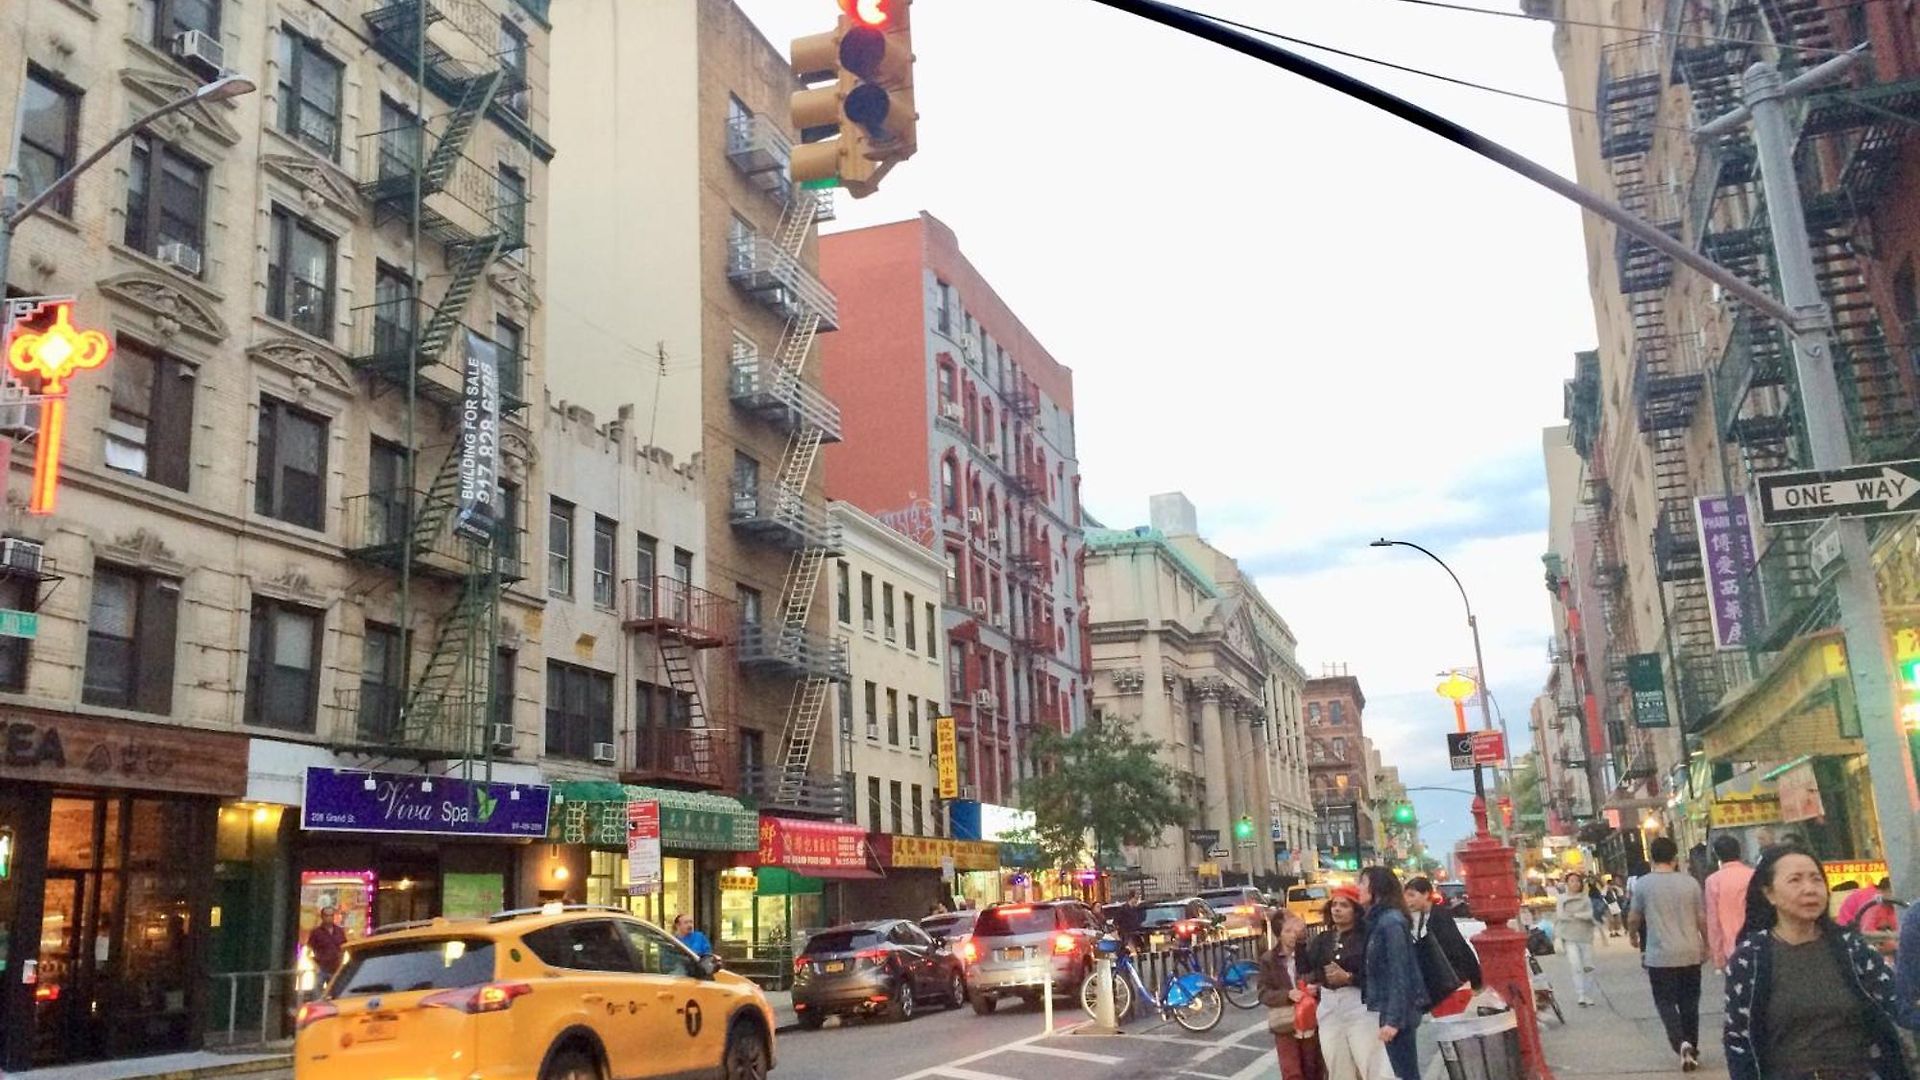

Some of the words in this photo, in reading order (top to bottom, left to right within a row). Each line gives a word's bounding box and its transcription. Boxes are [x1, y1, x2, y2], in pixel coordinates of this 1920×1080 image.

[467, 357, 480, 396] SALE
[464, 399, 478, 430] FOR
[462, 435, 477, 500] BUILDING
[476, 465, 493, 504] 917
[1785, 484, 1834, 507] ONE
[1856, 477, 1907, 501] WAY
[377, 780, 432, 821] Viva
[442, 801, 469, 825] Spa
[687, 1006, 699, 1033] T
